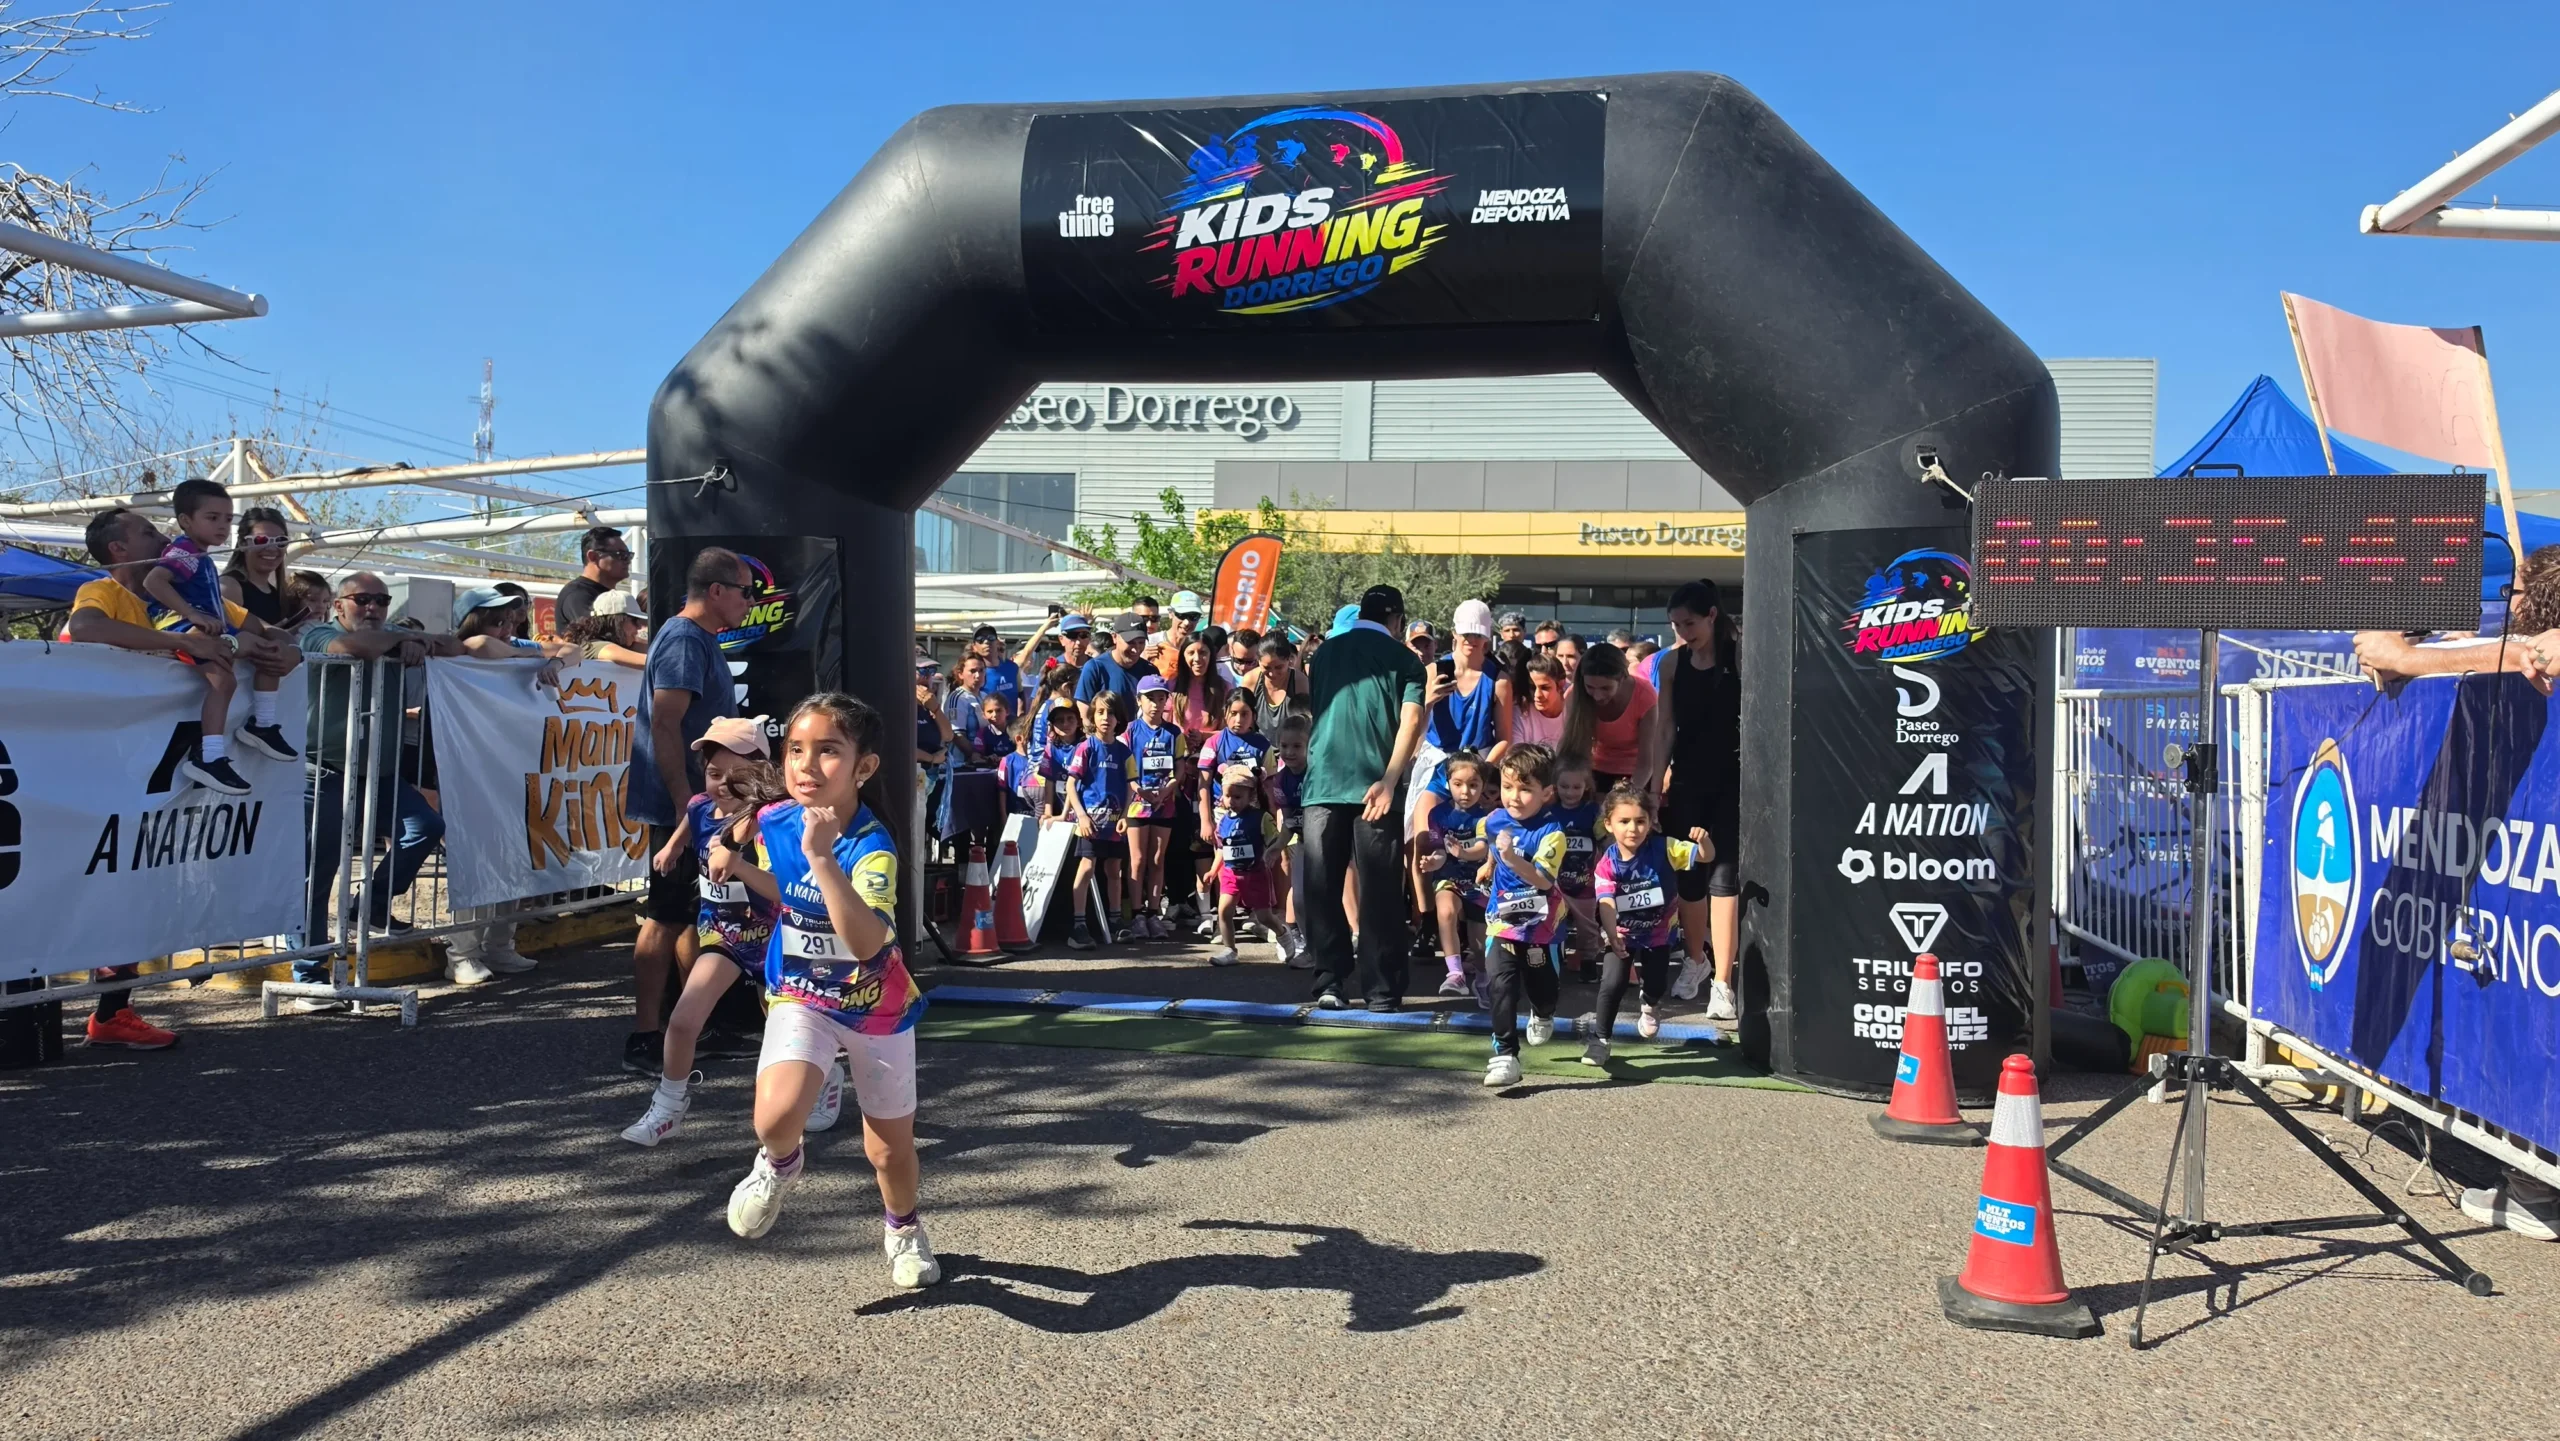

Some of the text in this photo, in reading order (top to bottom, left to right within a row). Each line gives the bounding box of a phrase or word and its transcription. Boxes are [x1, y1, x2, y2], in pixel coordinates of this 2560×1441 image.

[1075, 194, 1114, 215] free
[1478, 186, 1566, 206] MENDOZA
[1058, 210, 1114, 238] time
[1175, 187, 1334, 250] KIDS
[1470, 203, 1570, 224] DEPORTIVA
[1172, 197, 1424, 299] RUNNING
[1223, 255, 1385, 308] DORREGO
[1004, 385, 1293, 437] seo Dorrego
[1578, 519, 1746, 549] Paseo Dorreg
[1229, 550, 1260, 627] TORIO
[1858, 598, 1945, 629] KIDS
[716, 624, 768, 643] RREGO
[1854, 611, 1977, 654] RUNNIN
[1881, 632, 1969, 659] DORREGO
[2076, 654, 2106, 666] ntos
[2256, 648, 2362, 679] SISTEM
[1896, 718, 1940, 731] Paseo
[540, 705, 637, 774] Maní
[1896, 730, 1960, 746] Dorrego
[1150, 758, 1165, 768] 337
[525, 766, 650, 871] King
[1854, 802, 1990, 837] A NATION
[84, 813, 120, 875] A
[131, 800, 263, 871] NATION
[1566, 838, 1584, 849] 224
[1231, 848, 1245, 858] 274
[2371, 804, 2560, 897] MENDOZA
[1883, 851, 1996, 881] bloom
[707, 881, 730, 900] 297
[785, 881, 825, 904] A NATIO
[1628, 892, 1652, 909] 226
[1510, 899, 1535, 912] 203
[804, 917, 832, 926] TRIUNF
[800, 934, 836, 956] 291
[2371, 887, 2560, 997] GOBIERNO
[1852, 957, 1983, 978] TRIUFO
[1858, 977, 1979, 994] SEGOS
[1853, 1003, 1988, 1025] COREL
[1853, 1022, 1988, 1042] RODUEZ
[1986, 1203, 2012, 1218] MLT
